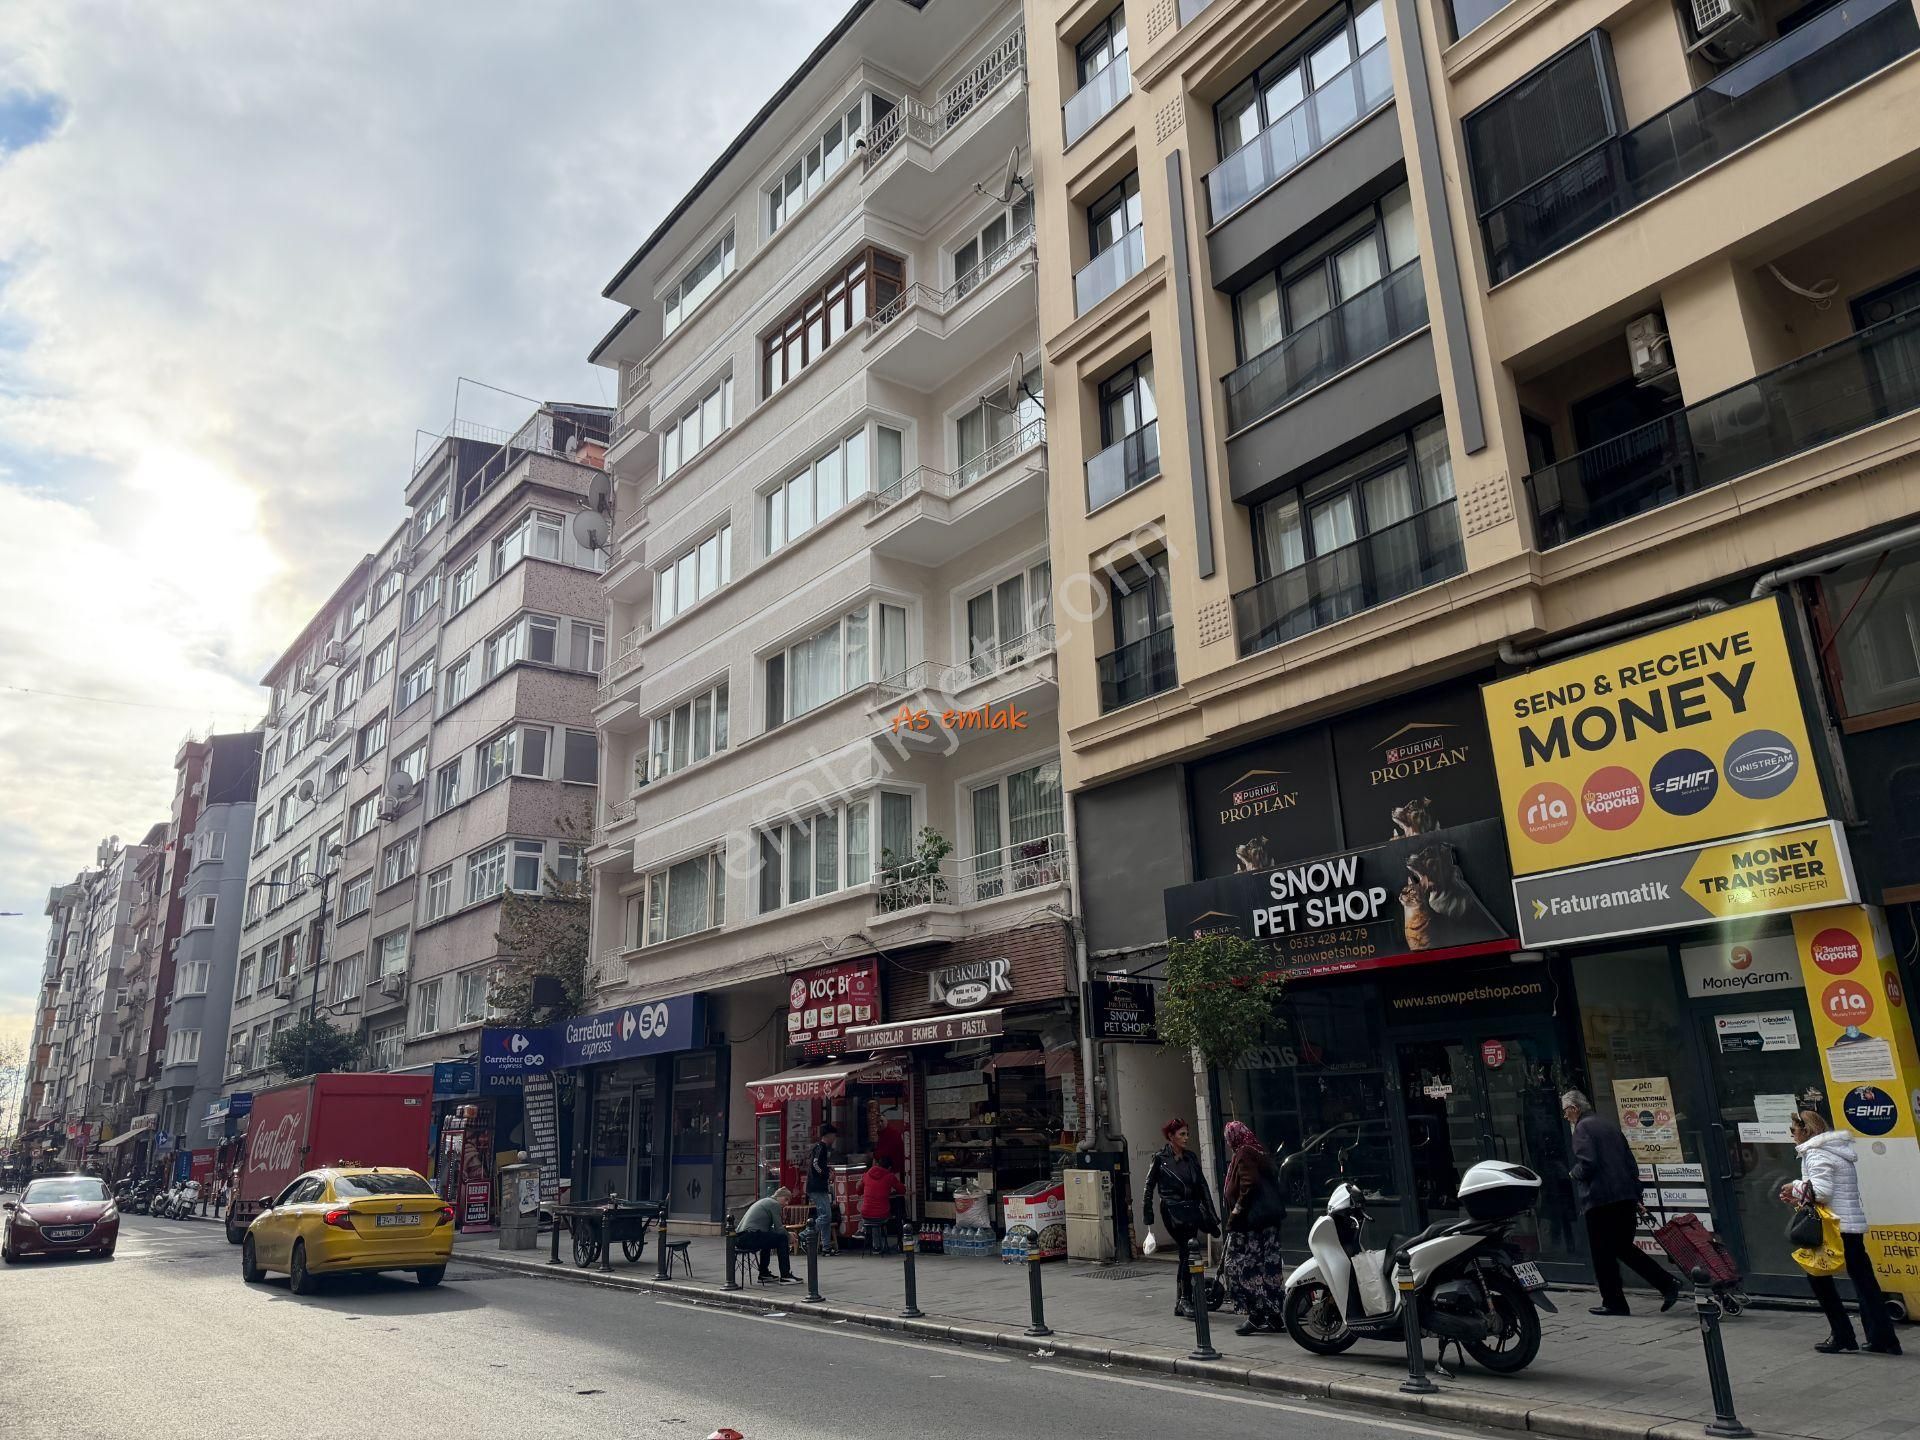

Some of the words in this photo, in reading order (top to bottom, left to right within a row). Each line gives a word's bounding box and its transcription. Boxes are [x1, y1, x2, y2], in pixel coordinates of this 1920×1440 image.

[1514, 683, 1586, 718] SEND
[1594, 674, 1613, 696] &
[1618, 631, 1752, 688] RECEIVE
[1518, 661, 1756, 768] MONEY
[1399, 740, 1441, 757] PURINA
[1370, 762, 1409, 786] PRO
[1412, 747, 1466, 775] PLAN
[1735, 753, 1793, 774] UNISTREAM
[1243, 784, 1276, 800] PURINA
[1665, 769, 1715, 793] SHIFT
[1586, 794, 1640, 815] Корона
[1596, 785, 1638, 803] Золотая
[1220, 803, 1251, 824] PRO
[1253, 792, 1296, 817] PLAN
[1527, 793, 1568, 825] ria
[1732, 839, 1819, 869] MONEY
[1269, 856, 1358, 900] SNOW
[1699, 860, 1825, 893] TRANSFER
[1550, 882, 1670, 917] Faturamatik
[1727, 889, 1757, 904] PAA
[1760, 878, 1828, 899] TRANSFERİ
[1252, 902, 1300, 937] PET
[1306, 886, 1387, 928] SHOP
[1289, 937, 1315, 950] 0533
[1317, 932, 1337, 946] 428
[1339, 930, 1352, 942] 42
[1354, 928, 1368, 940] 79
[1823, 944, 1857, 954] Золотая
[1290, 944, 1376, 964] snowpetshopp
[1815, 949, 1858, 962] Корона
[810, 977, 835, 1002] KOÇ
[1703, 970, 1790, 989] MoneyGram
[1392, 982, 1542, 1009] www.snowpetshop.com
[1830, 988, 1866, 1011] ria
[566, 1018, 614, 1044] Carrefour
[640, 1006, 668, 1036] SA
[1104, 1021, 1120, 1032] PET
[1110, 1011, 1138, 1022] SNOW
[856, 1029, 904, 1048] KULAKSIZLAR
[912, 1025, 938, 1041] EKMEK
[946, 1023, 953, 1037] &
[962, 1019, 988, 1036] PASTA
[484, 1055, 524, 1064] Carrefour
[581, 1040, 612, 1060] express
[773, 1084, 794, 1101] KOÇ
[795, 1081, 820, 1096] BÜFE
[1856, 1104, 1895, 1117] SHIFT
[1645, 1144, 1661, 1152] 200
[1870, 1230, 1920, 1242] ПЕРЕВО
